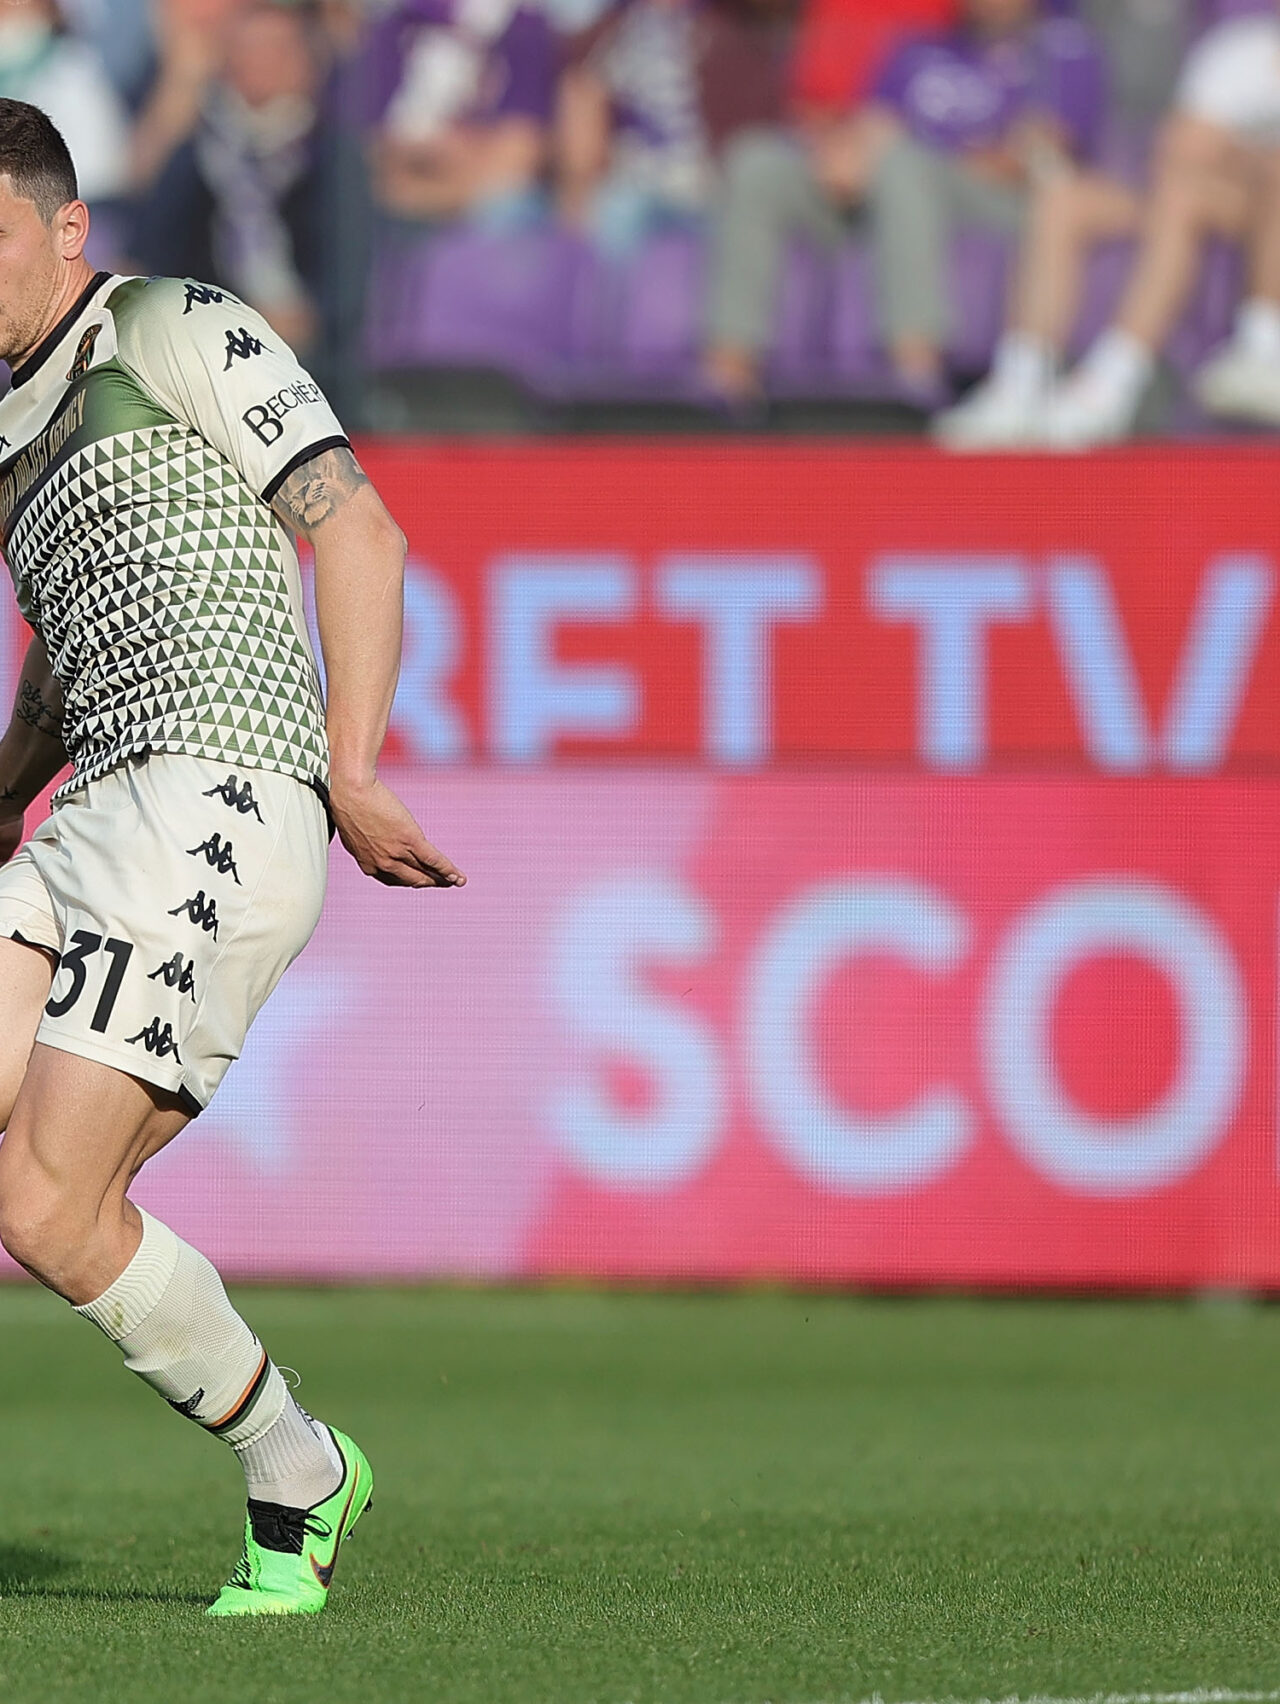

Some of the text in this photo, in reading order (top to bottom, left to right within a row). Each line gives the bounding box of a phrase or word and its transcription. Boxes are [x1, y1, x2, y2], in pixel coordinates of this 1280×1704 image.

[48, 388, 86, 461] AGENCY
[45, 929, 134, 1034] 31
[550, 872, 1250, 1198] SCO
